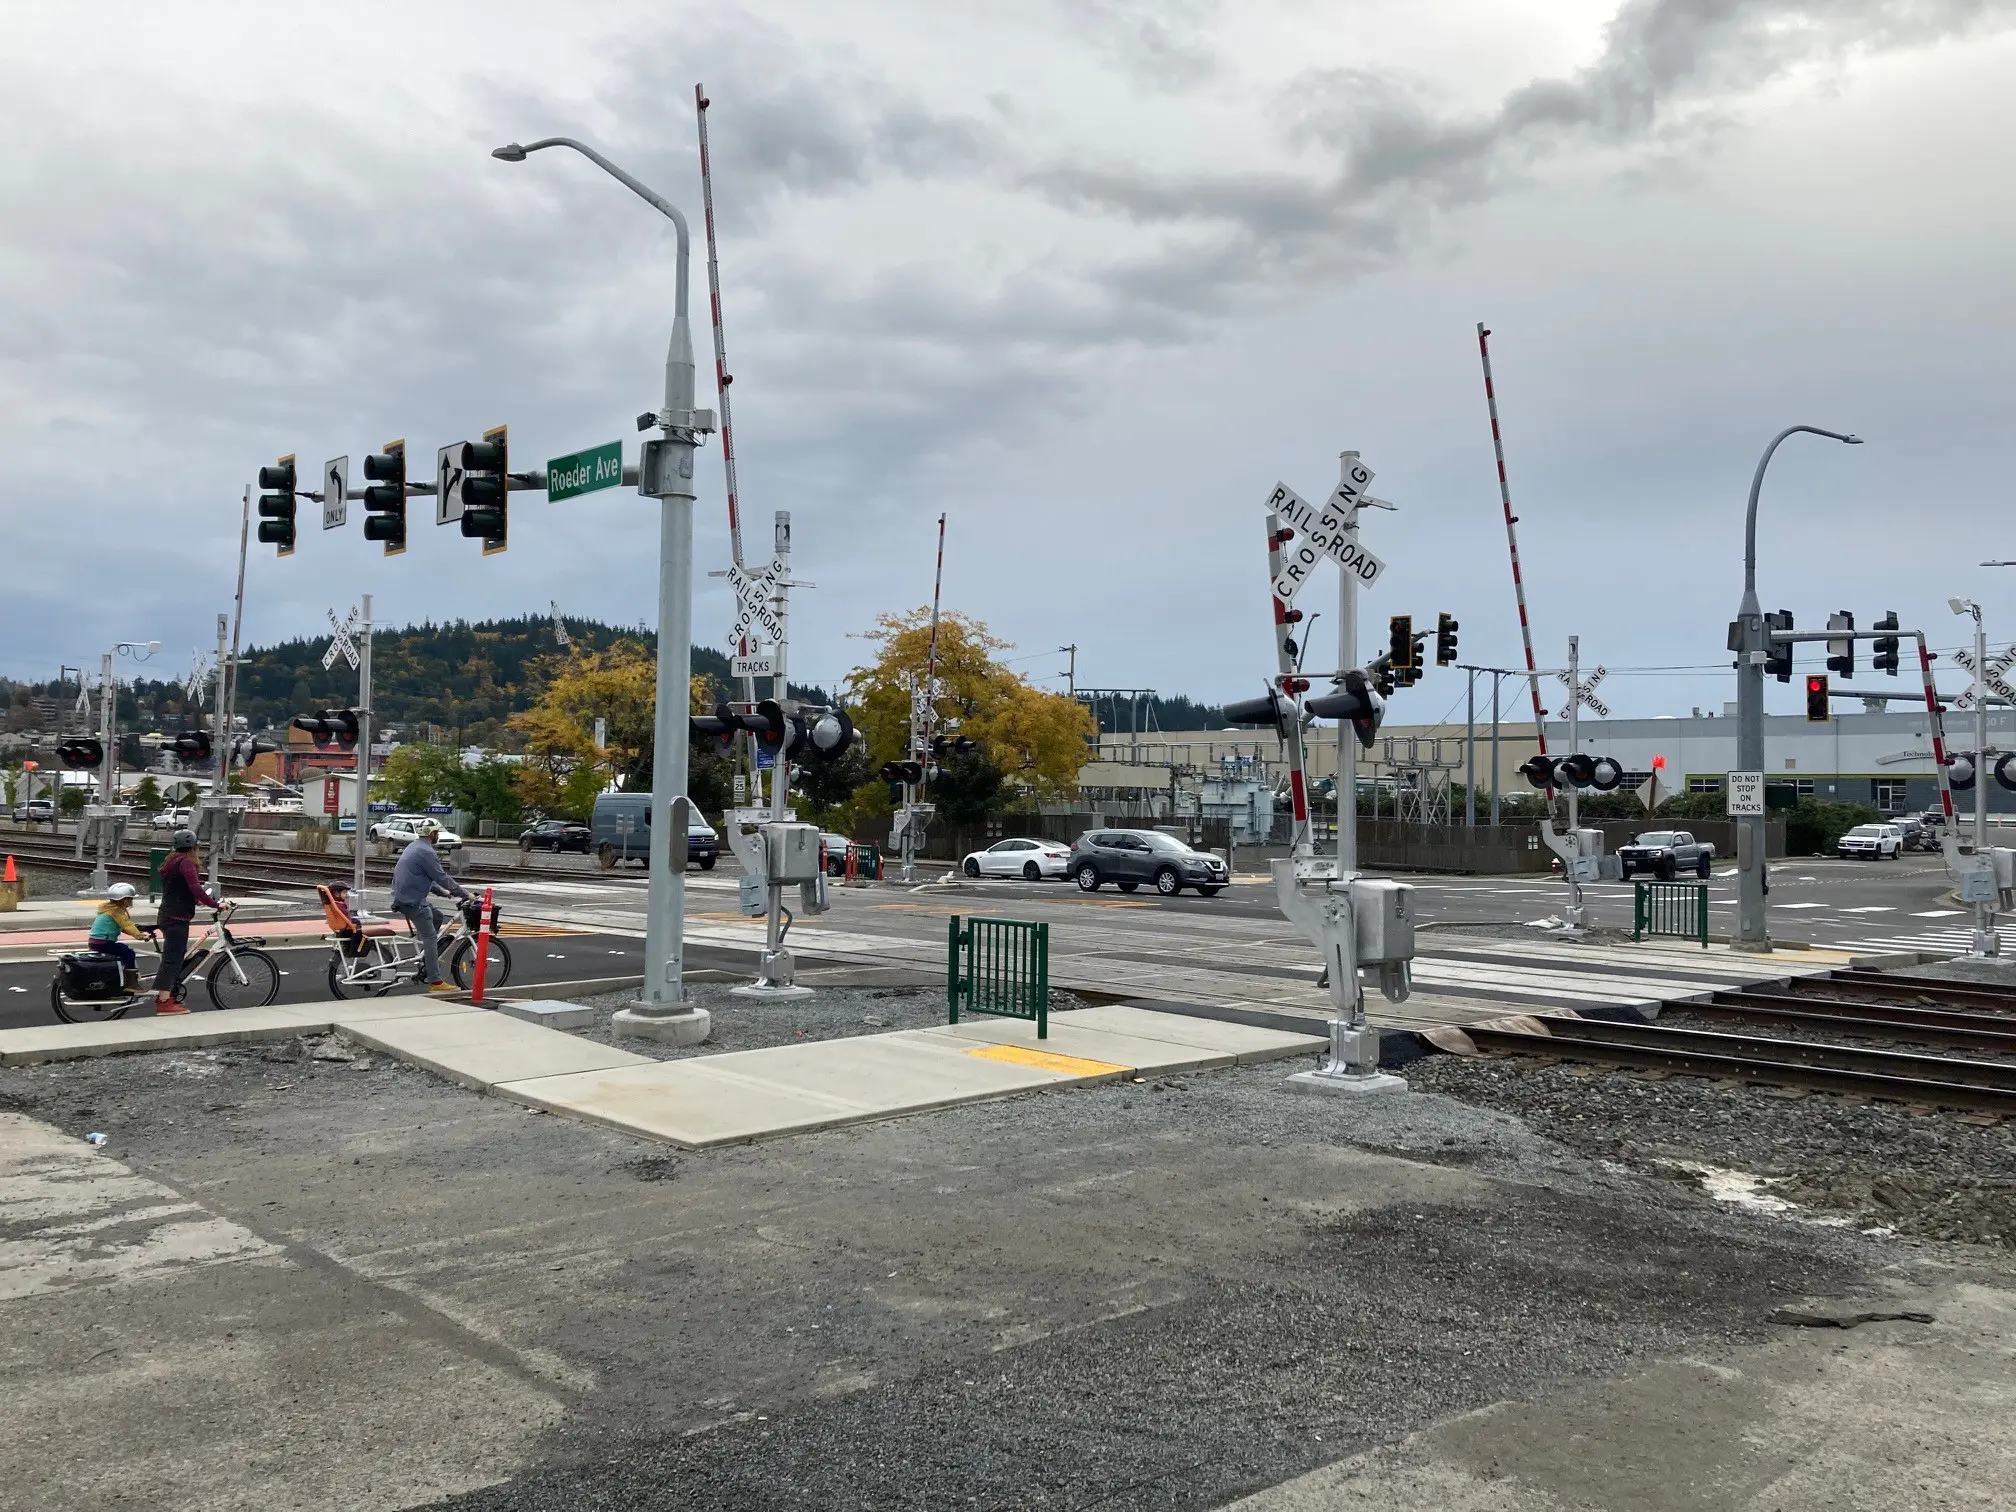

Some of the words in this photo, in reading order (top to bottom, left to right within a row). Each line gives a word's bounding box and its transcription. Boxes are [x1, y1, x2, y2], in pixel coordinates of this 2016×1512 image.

[551, 466, 590, 493] Roeder
[596, 456, 618, 481] Ave
[326, 507, 344, 524] ONLY
[1277, 466, 1368, 598] CROSSING
[728, 560, 782, 646] CROSSING
[324, 606, 358, 667] CROSSING
[750, 638, 758, 653] 3
[737, 662, 769, 672] TRACKS
